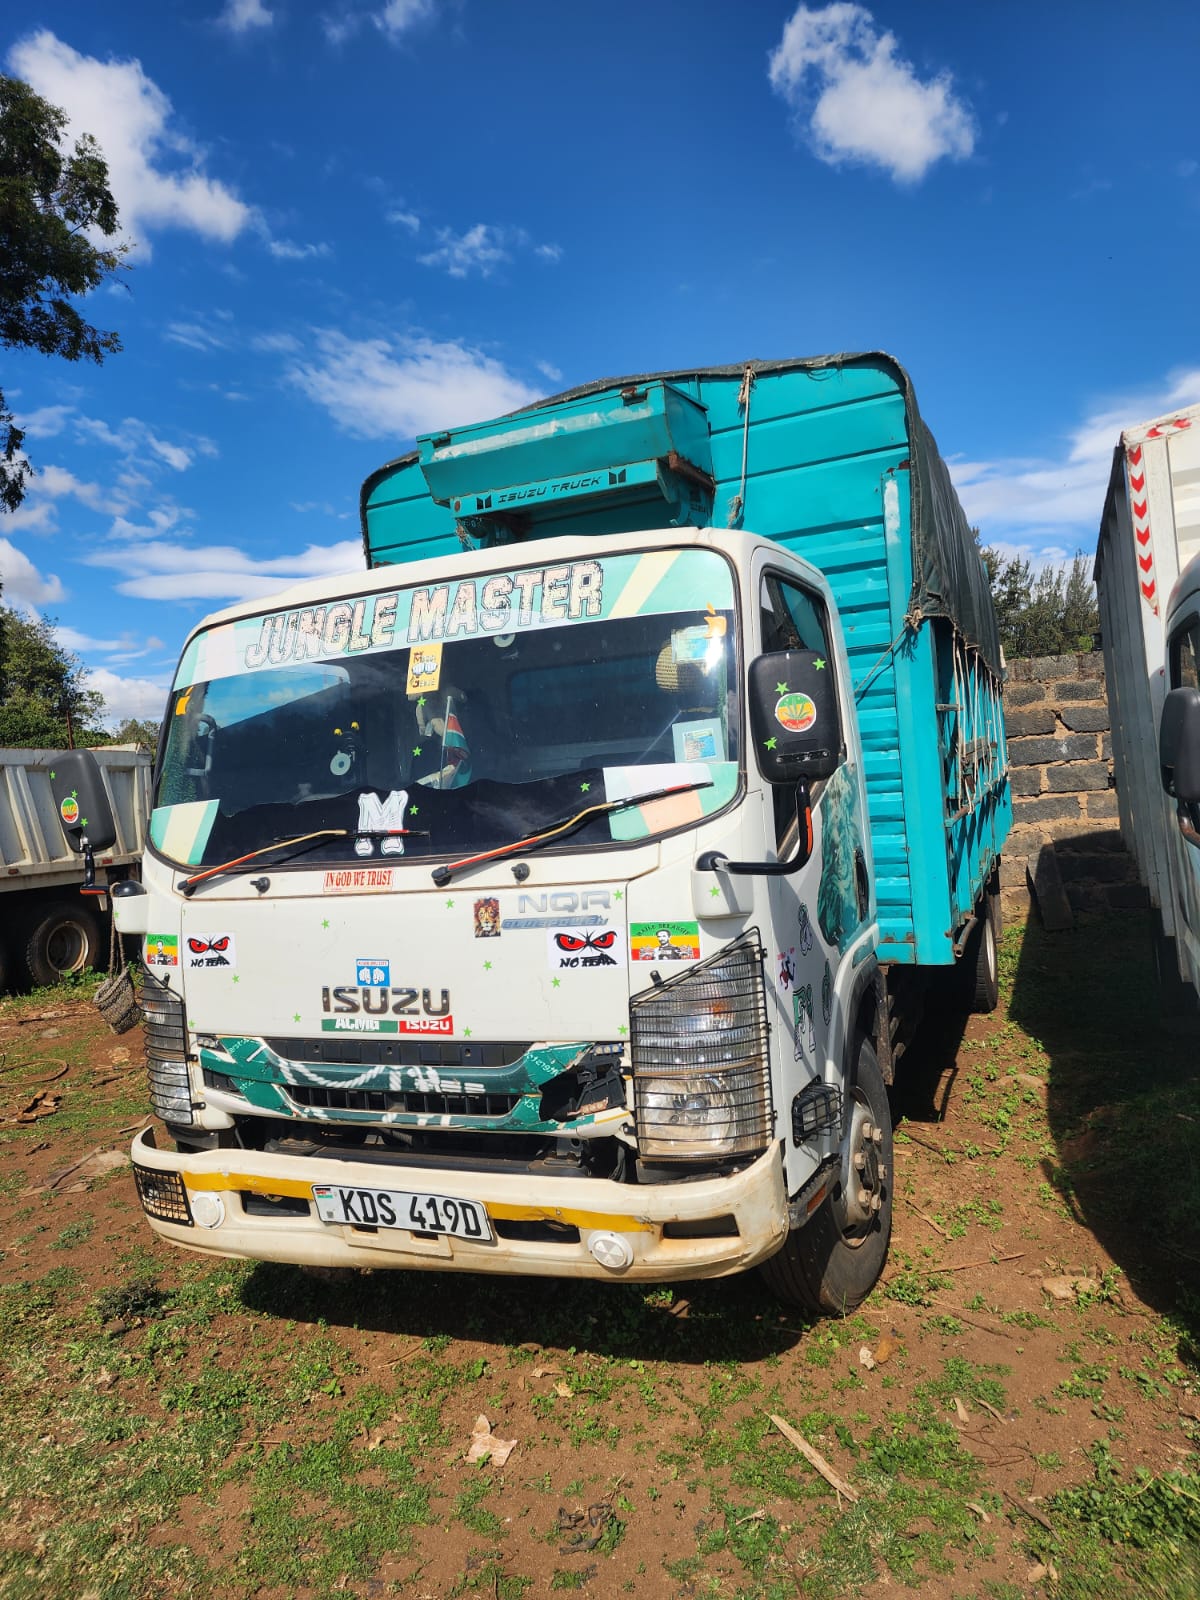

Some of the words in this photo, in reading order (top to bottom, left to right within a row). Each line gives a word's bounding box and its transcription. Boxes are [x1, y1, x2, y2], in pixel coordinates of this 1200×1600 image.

[498, 486, 547, 504] ISUZU
[551, 476, 603, 494] TRUCK
[244, 594, 399, 668] JUNGLE
[407, 561, 604, 643] MASTER
[325, 872, 334, 888] IN
[335, 871, 352, 887] GOD
[353, 871, 365, 886] WE
[367, 870, 393, 886] TRUST
[518, 890, 612, 913] NQR
[190, 958, 204, 968] NO
[559, 957, 579, 968] NO
[321, 986, 451, 1016] ISUZU
[405, 1020, 450, 1031] ISUZU
[338, 1189, 396, 1226] KDS
[409, 1196, 482, 1237] 419D
